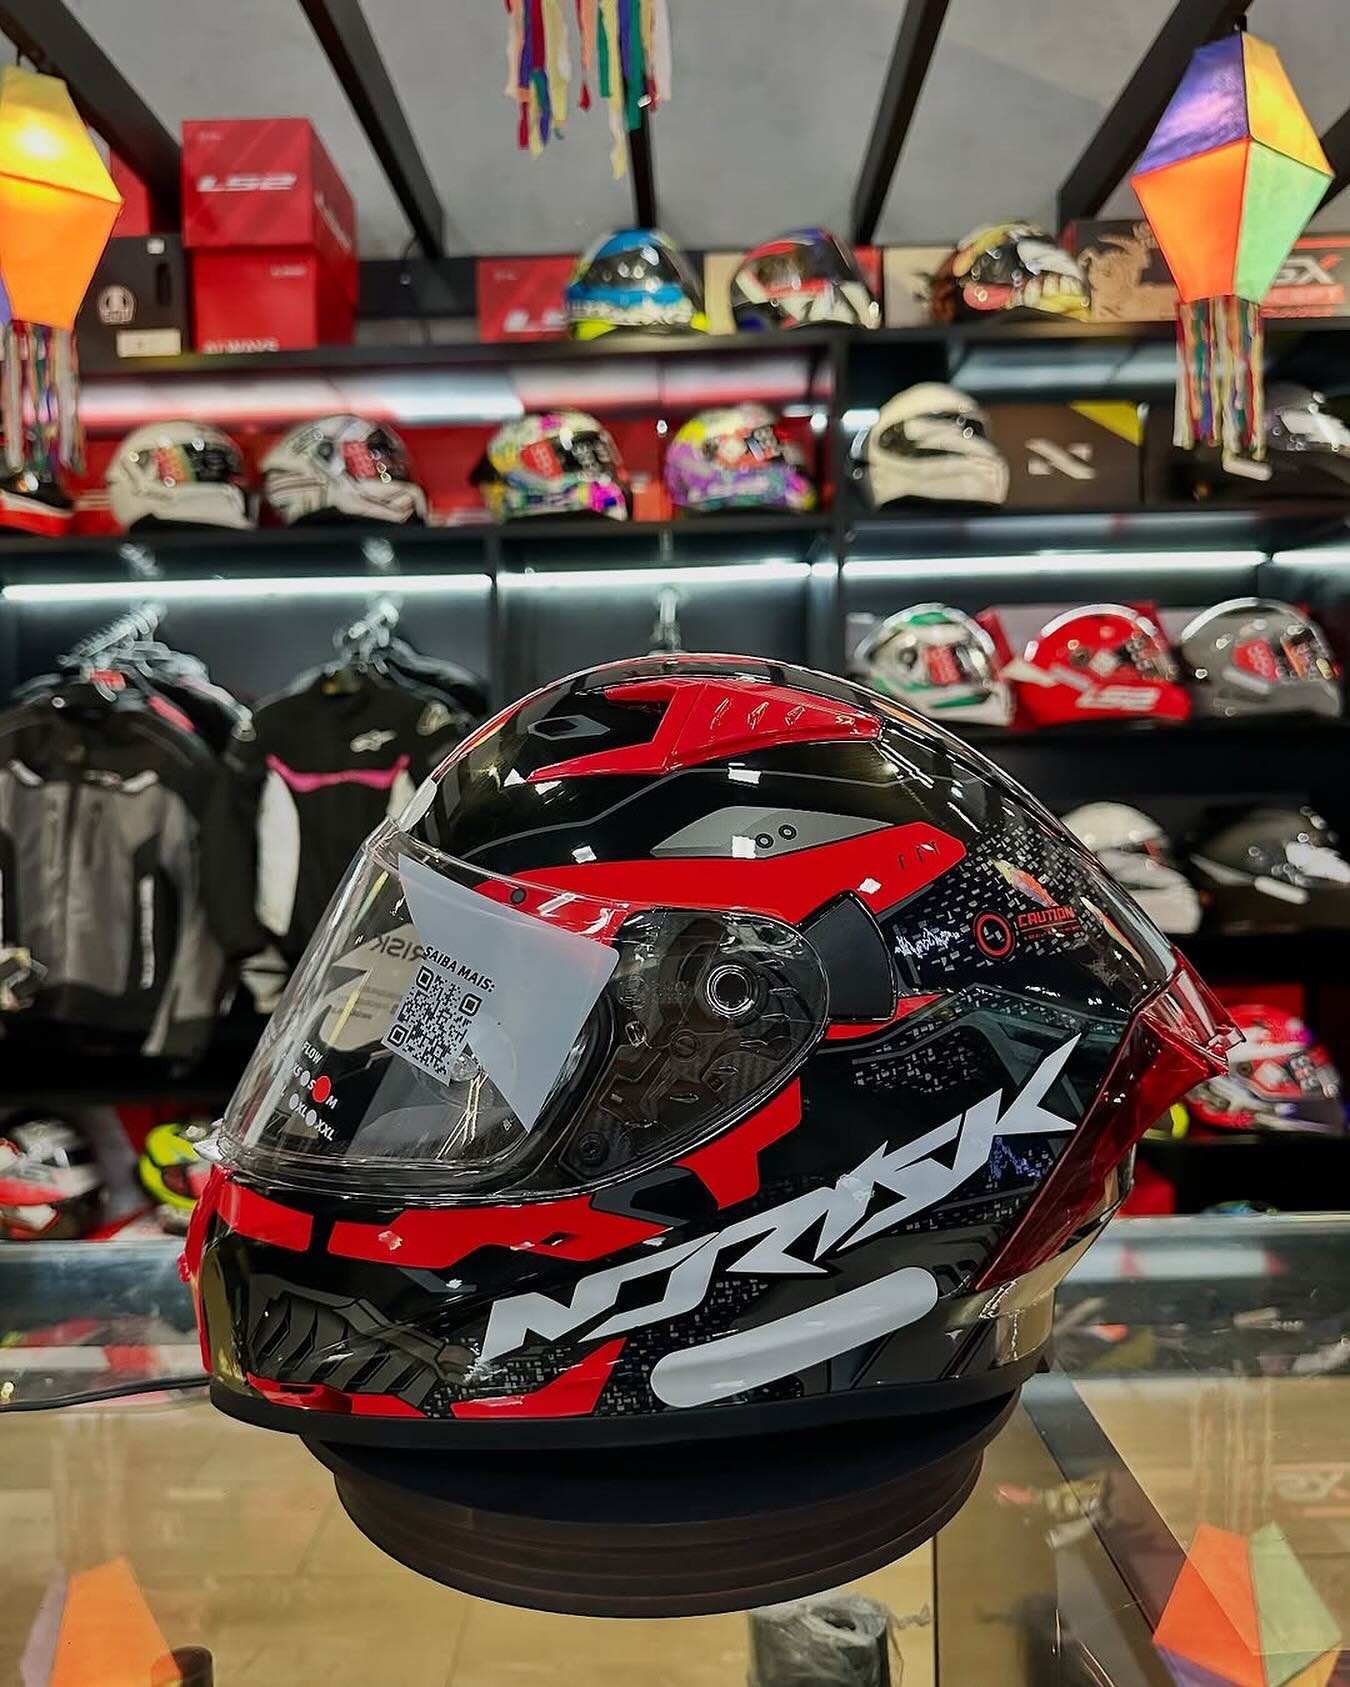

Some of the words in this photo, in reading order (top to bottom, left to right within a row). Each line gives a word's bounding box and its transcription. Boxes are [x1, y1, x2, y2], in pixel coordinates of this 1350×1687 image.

[197, 171, 297, 192] LS2
[1017, 906, 1076, 928] CAUTION
[423, 946, 458, 973] SAIBA
[457, 965, 496, 993] MAIS:
[302, 1041, 324, 1064] FLOW
[307, 1079, 317, 1091] S
[325, 1095, 339, 1110] M
[295, 1101, 308, 1119] XL
[314, 1118, 336, 1142] XXL
